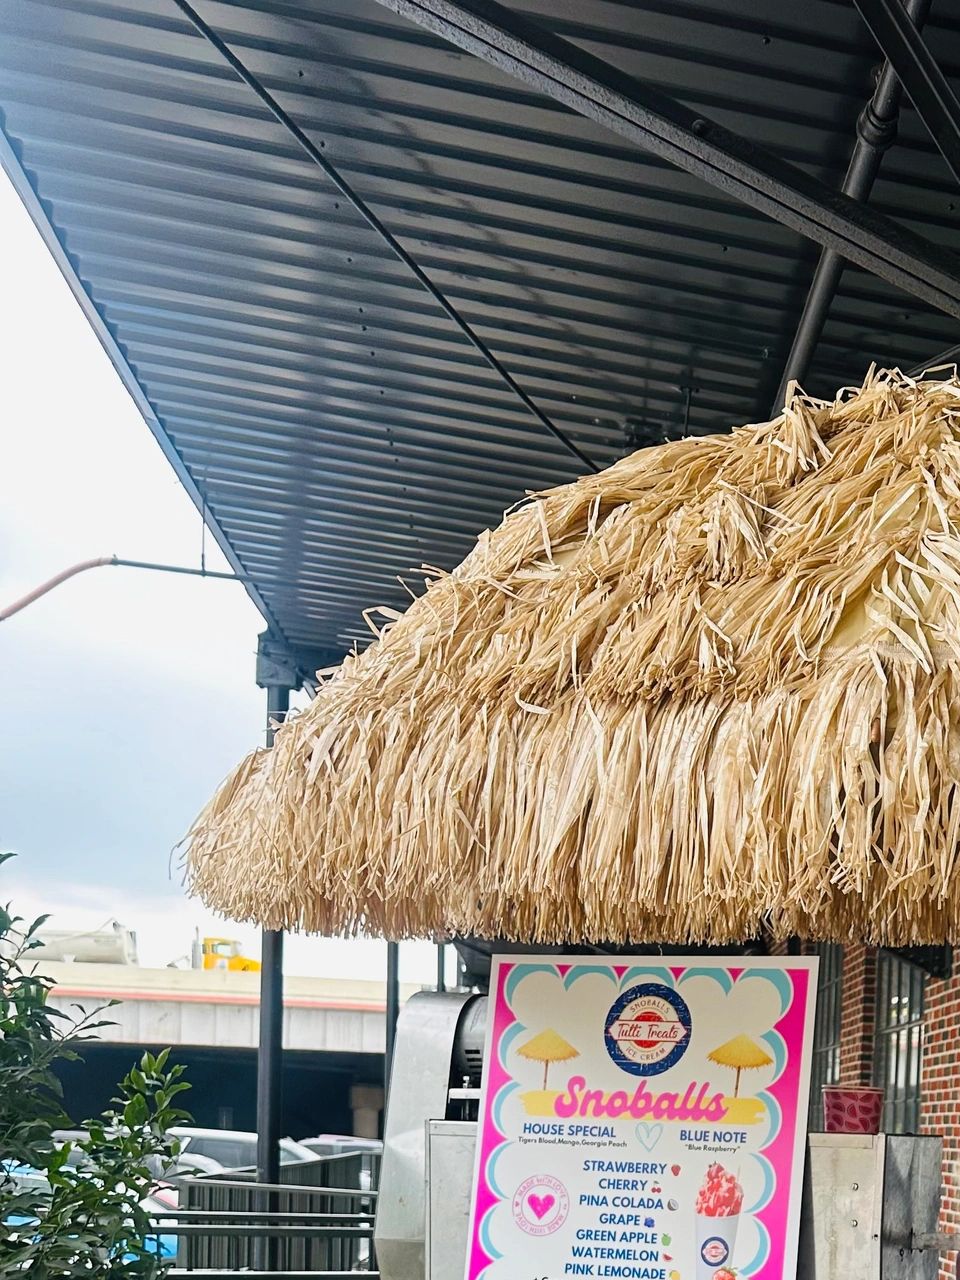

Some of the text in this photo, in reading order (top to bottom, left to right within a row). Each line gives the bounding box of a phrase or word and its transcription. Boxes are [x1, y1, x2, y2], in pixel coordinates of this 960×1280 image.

[629, 999, 670, 1014] SNOBALLS
[618, 1023, 680, 1039] Tutti Treats
[626, 1047, 667, 1060] ICE CREAM
[554, 1075, 730, 1122] Snoballs
[523, 1123, 617, 1138] HOUSE SPECIAL
[680, 1130, 747, 1143] BLUE NOTE
[518, 1136, 537, 1144] Tigers
[583, 1160, 667, 1175] STRAWBERRY
[599, 1178, 648, 1191] CHERRY
[579, 1194, 664, 1210] PINA COLADA
[599, 1213, 641, 1226] GRAPE
[576, 1229, 658, 1244] GREEN APPLE
[572, 1245, 659, 1262] WATERMELON
[565, 1263, 666, 1280] PINK LEMONADE
